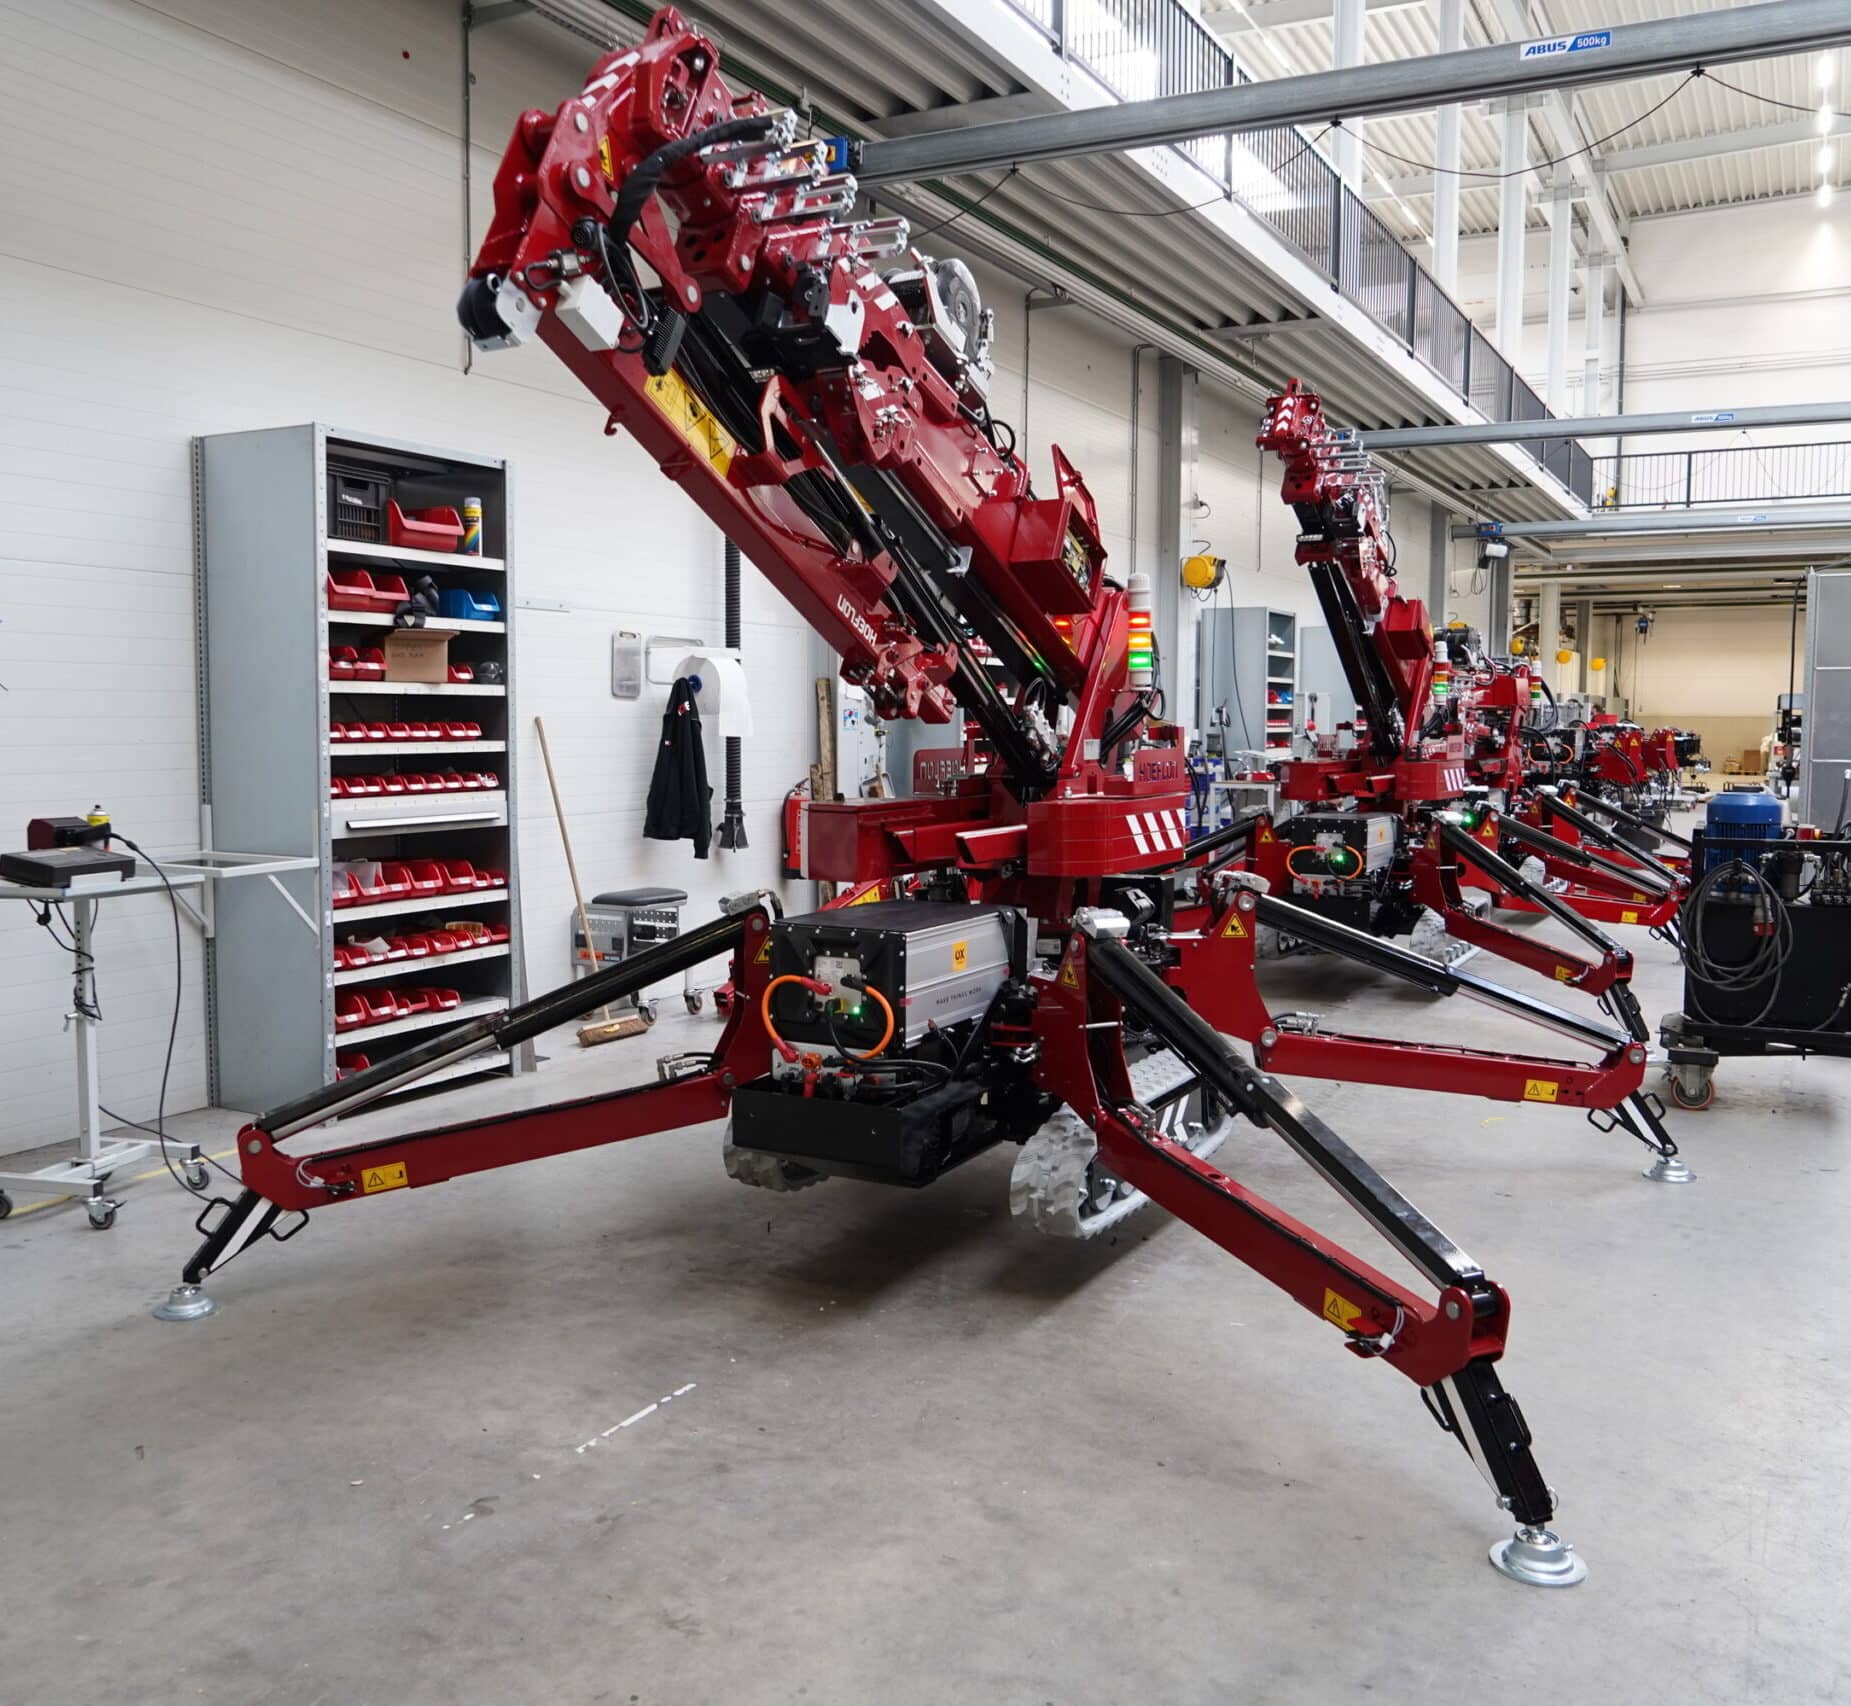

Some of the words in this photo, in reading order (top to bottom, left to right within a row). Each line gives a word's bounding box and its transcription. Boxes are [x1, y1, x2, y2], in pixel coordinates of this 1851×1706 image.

[1525, 41, 1567, 56] ABUS
[1577, 36, 1607, 48] 500kg
[837, 593, 878, 647] HOEFLON
[1139, 761, 1178, 781] HOEFLON
